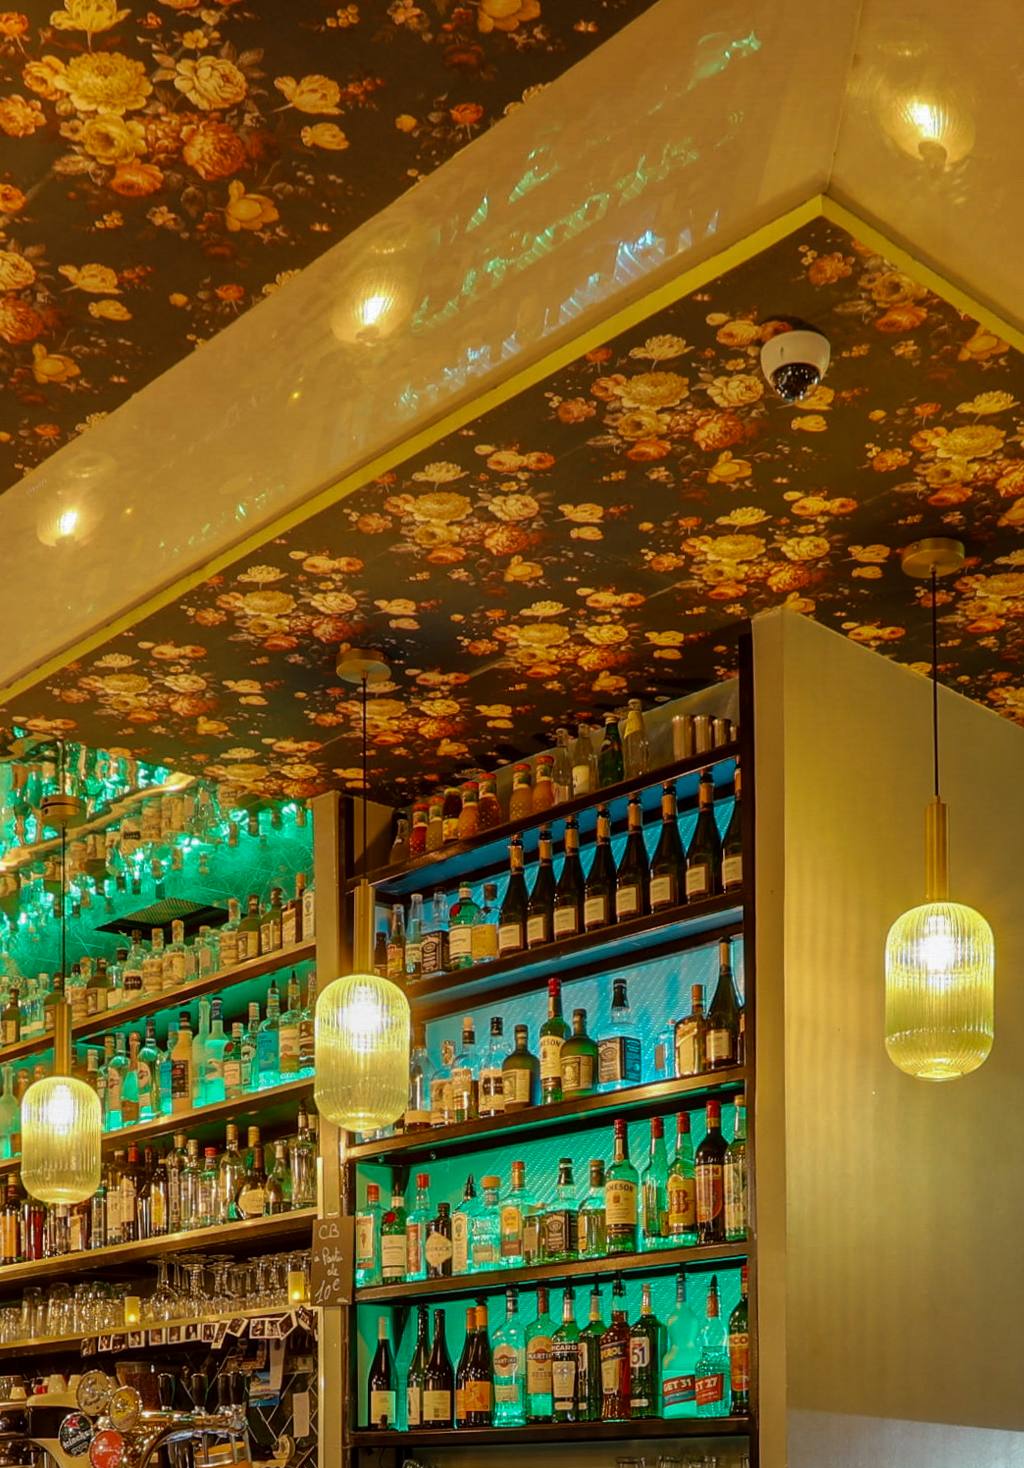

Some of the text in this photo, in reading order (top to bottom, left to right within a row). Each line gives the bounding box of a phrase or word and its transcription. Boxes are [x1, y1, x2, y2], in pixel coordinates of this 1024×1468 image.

[318, 1223, 340, 1240] CB
[327, 1263, 340, 1277] de
[631, 1345, 645, 1365] 51
[663, 1378, 692, 1393] GET 31
[704, 1376, 718, 1388] 27
